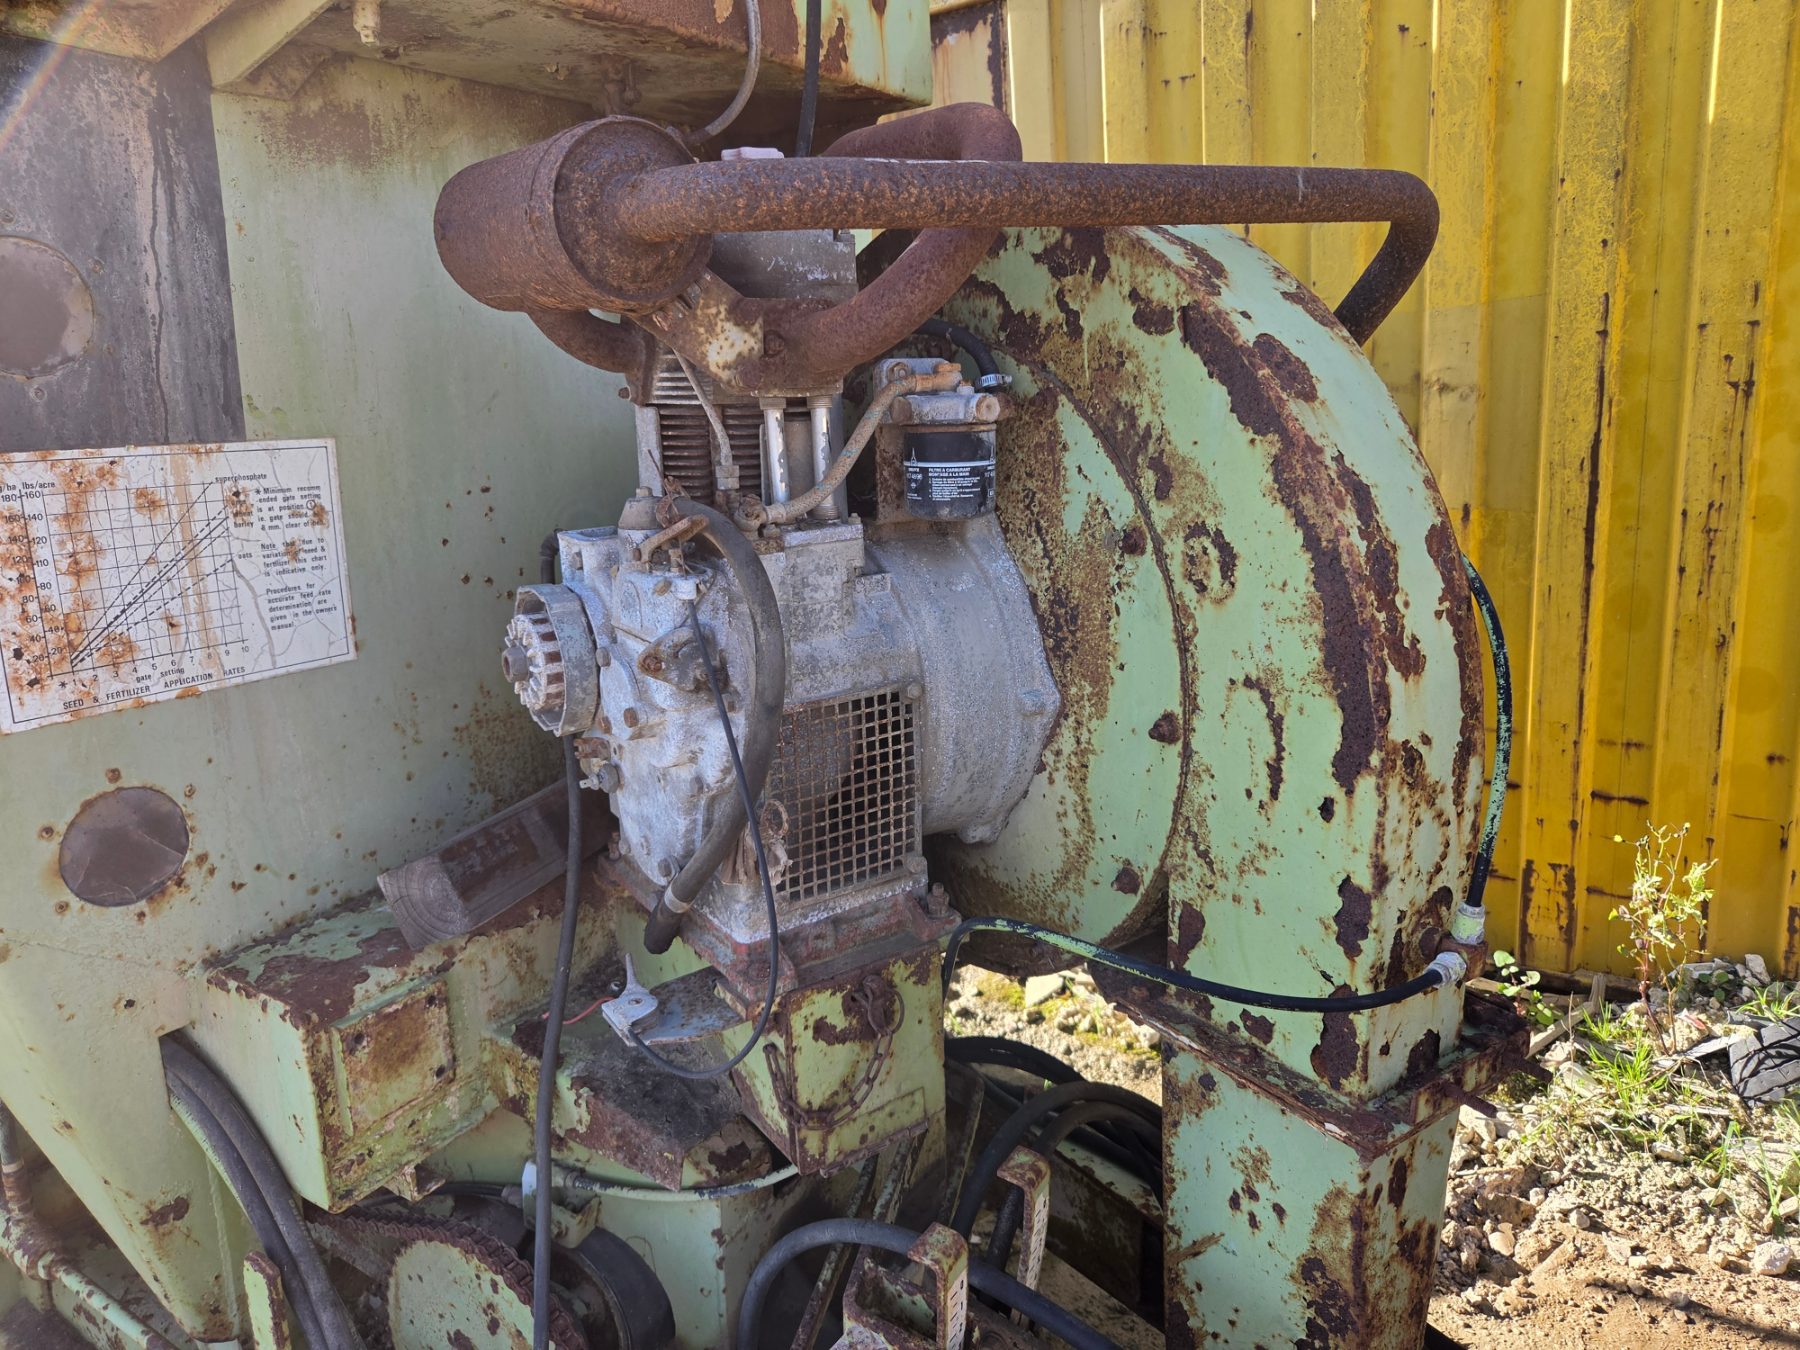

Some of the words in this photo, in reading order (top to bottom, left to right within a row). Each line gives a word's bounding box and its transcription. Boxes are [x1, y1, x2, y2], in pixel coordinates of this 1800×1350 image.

[216, 473, 267, 482] superphosphate
[22, 480, 56, 489] lbs/acre
[1, 494, 16, 502] 180
[25, 490, 41, 499] 160
[28, 513, 43, 521] 140
[270, 514, 283, 522] gate
[234, 520, 253, 528] barley
[32, 536, 47, 544] 120
[36, 559, 49, 567] 110
[276, 567, 306, 576] indicative
[40, 582, 52, 590] 80
[266, 585, 301, 596] Procedures
[22, 595, 34, 604] 80
[267, 596, 294, 604] accurate
[300, 591, 313, 599] feed
[269, 601, 312, 613] determination
[26, 614, 38, 623] 60
[270, 614, 287, 623] given
[92, 674, 98, 682] 2
[132, 666, 138, 674] 4
[136, 674, 151, 683] gate
[160, 668, 184, 677] setting
[63, 698, 84, 710] SEED
[106, 685, 150, 700] FERTILIZER
[164, 673, 213, 689] APPLICATION
